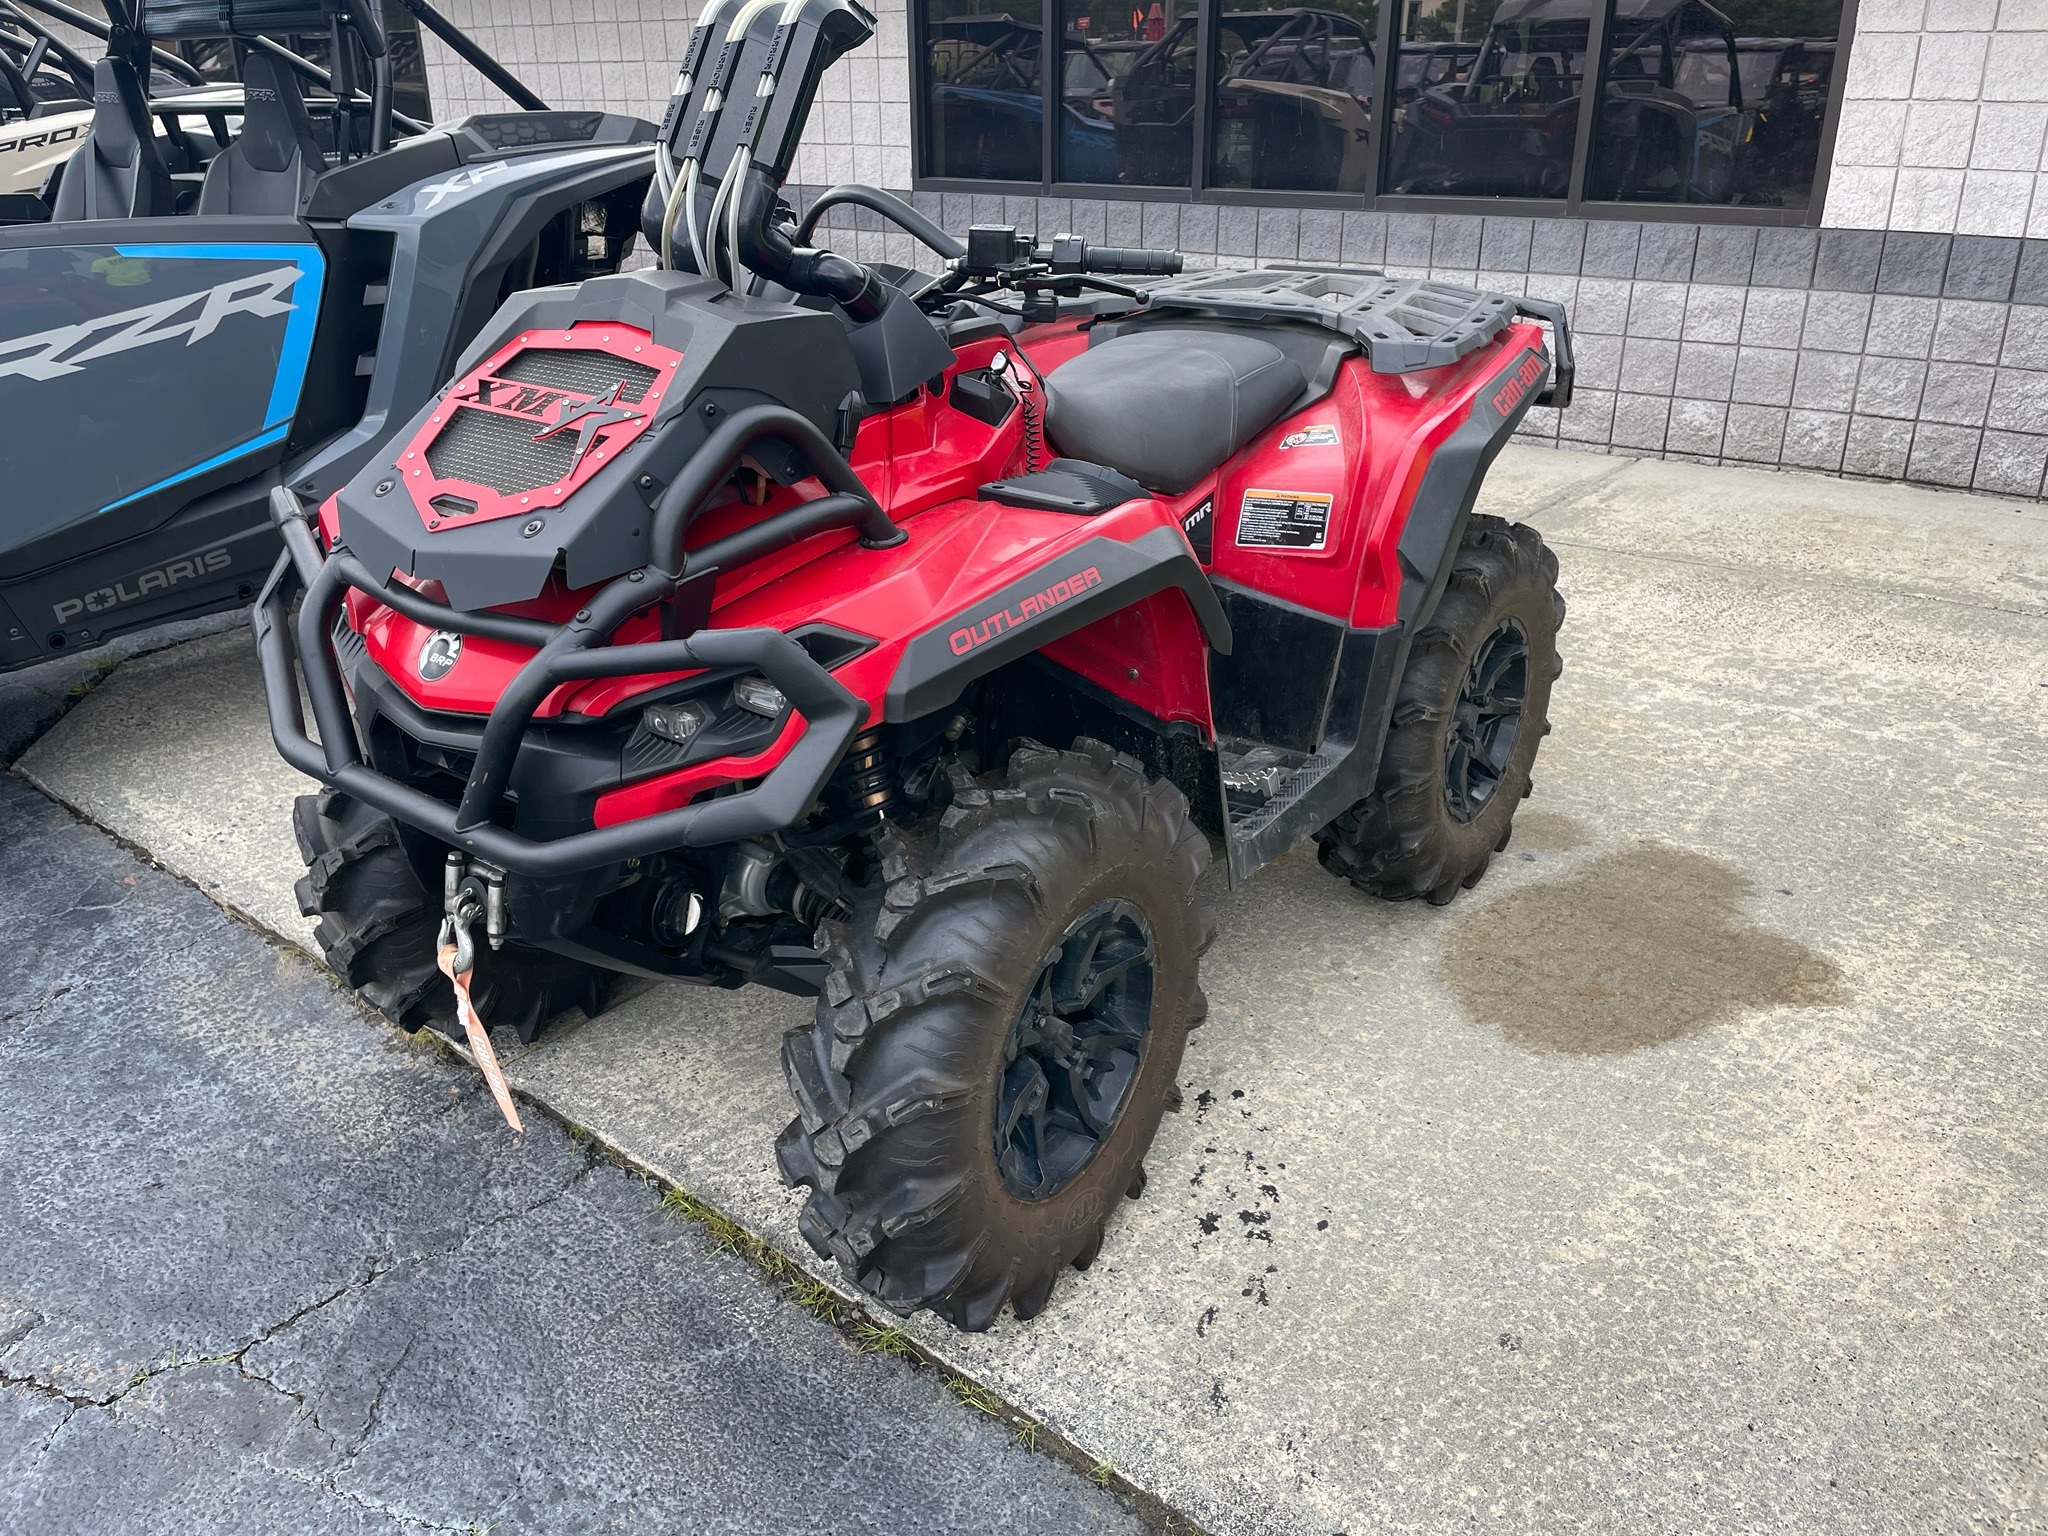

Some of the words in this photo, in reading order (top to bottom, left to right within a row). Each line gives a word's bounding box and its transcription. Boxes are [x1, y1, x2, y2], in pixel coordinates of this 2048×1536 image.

[682, 26, 702, 70] WARRIOR
[710, 42, 731, 86] WARRIOR
[764, 25, 785, 70] WARRIOR
[245, 87, 276, 102] RZR
[661, 103, 676, 130] RISER
[690, 119, 705, 148] RISER
[742, 106, 758, 134] RISER
[420, 160, 509, 211] XP
[0, 266, 305, 381] RZR
[52, 548, 232, 625] POLARIS
[949, 566, 1103, 657] OUTLANDER
[429, 652, 454, 667] BRP
